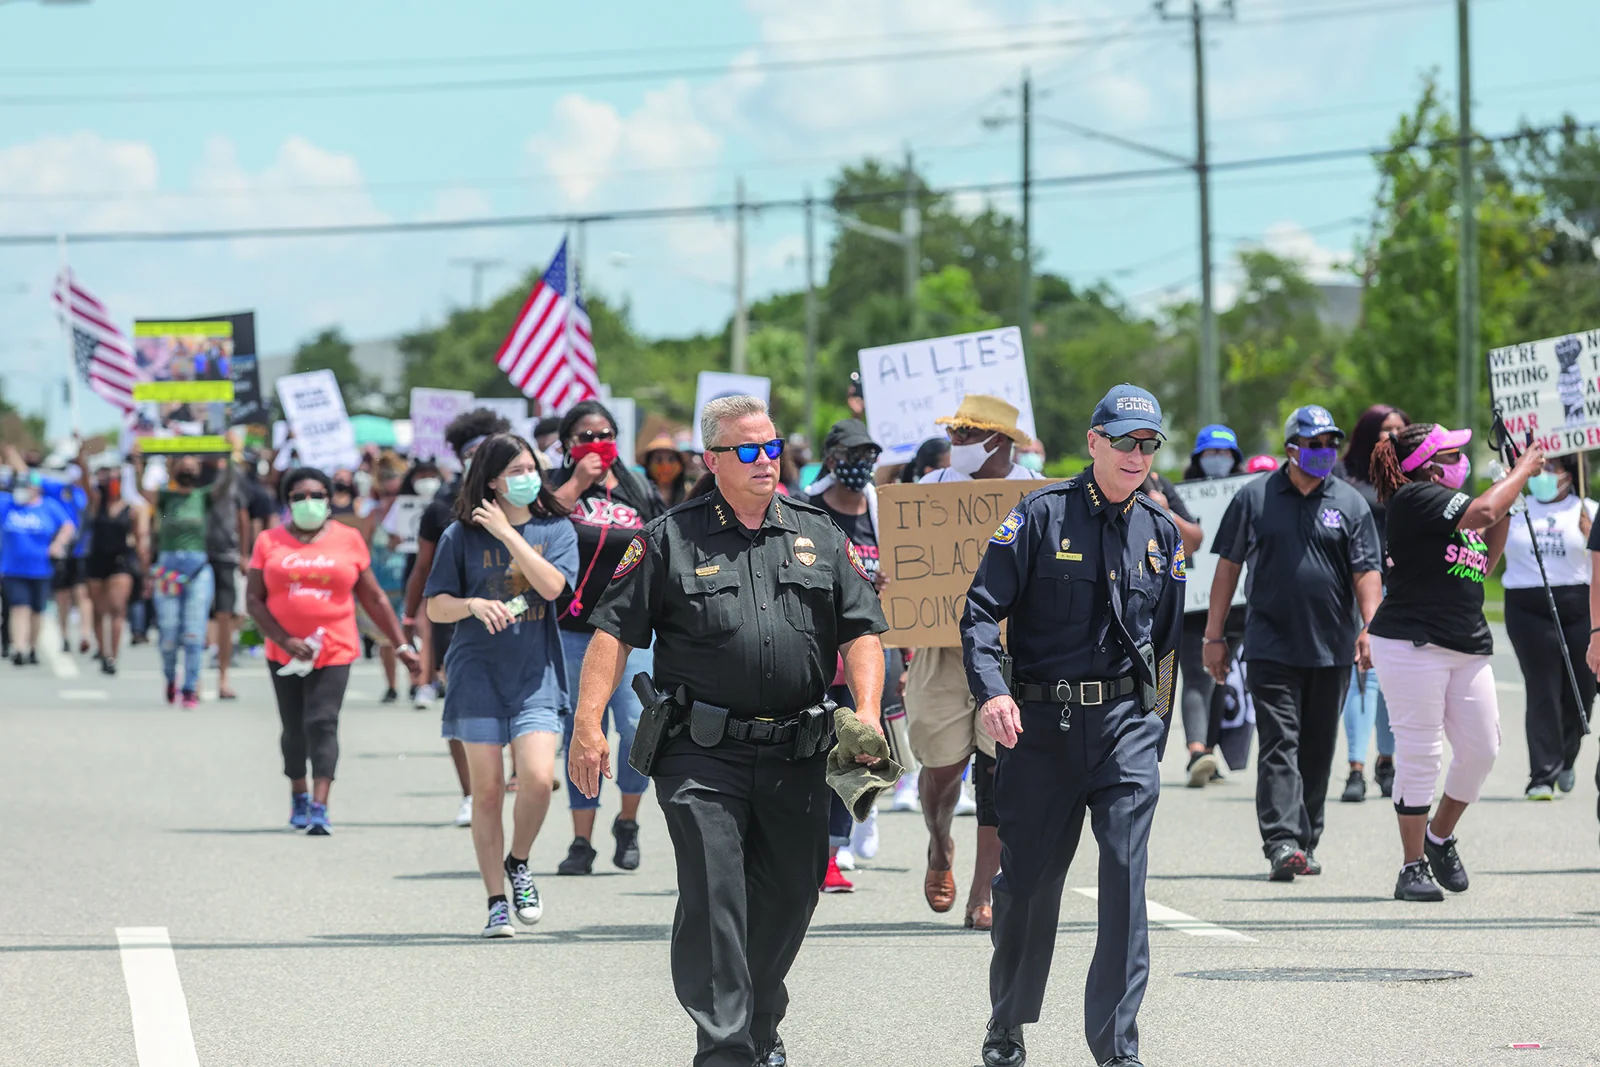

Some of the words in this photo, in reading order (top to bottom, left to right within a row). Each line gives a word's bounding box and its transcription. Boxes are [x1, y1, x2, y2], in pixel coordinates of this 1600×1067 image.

[878, 330, 1020, 385] ALLIES
[1490, 344, 1538, 367] WE'RE
[1493, 365, 1548, 388] TRYING
[1116, 402, 1156, 414] POLICE
[1495, 391, 1538, 412] START
[1565, 430, 1585, 449] TO
[1200, 486, 1218, 498] NO
[895, 494, 949, 530] IT'S
[957, 493, 1004, 526] NOT
